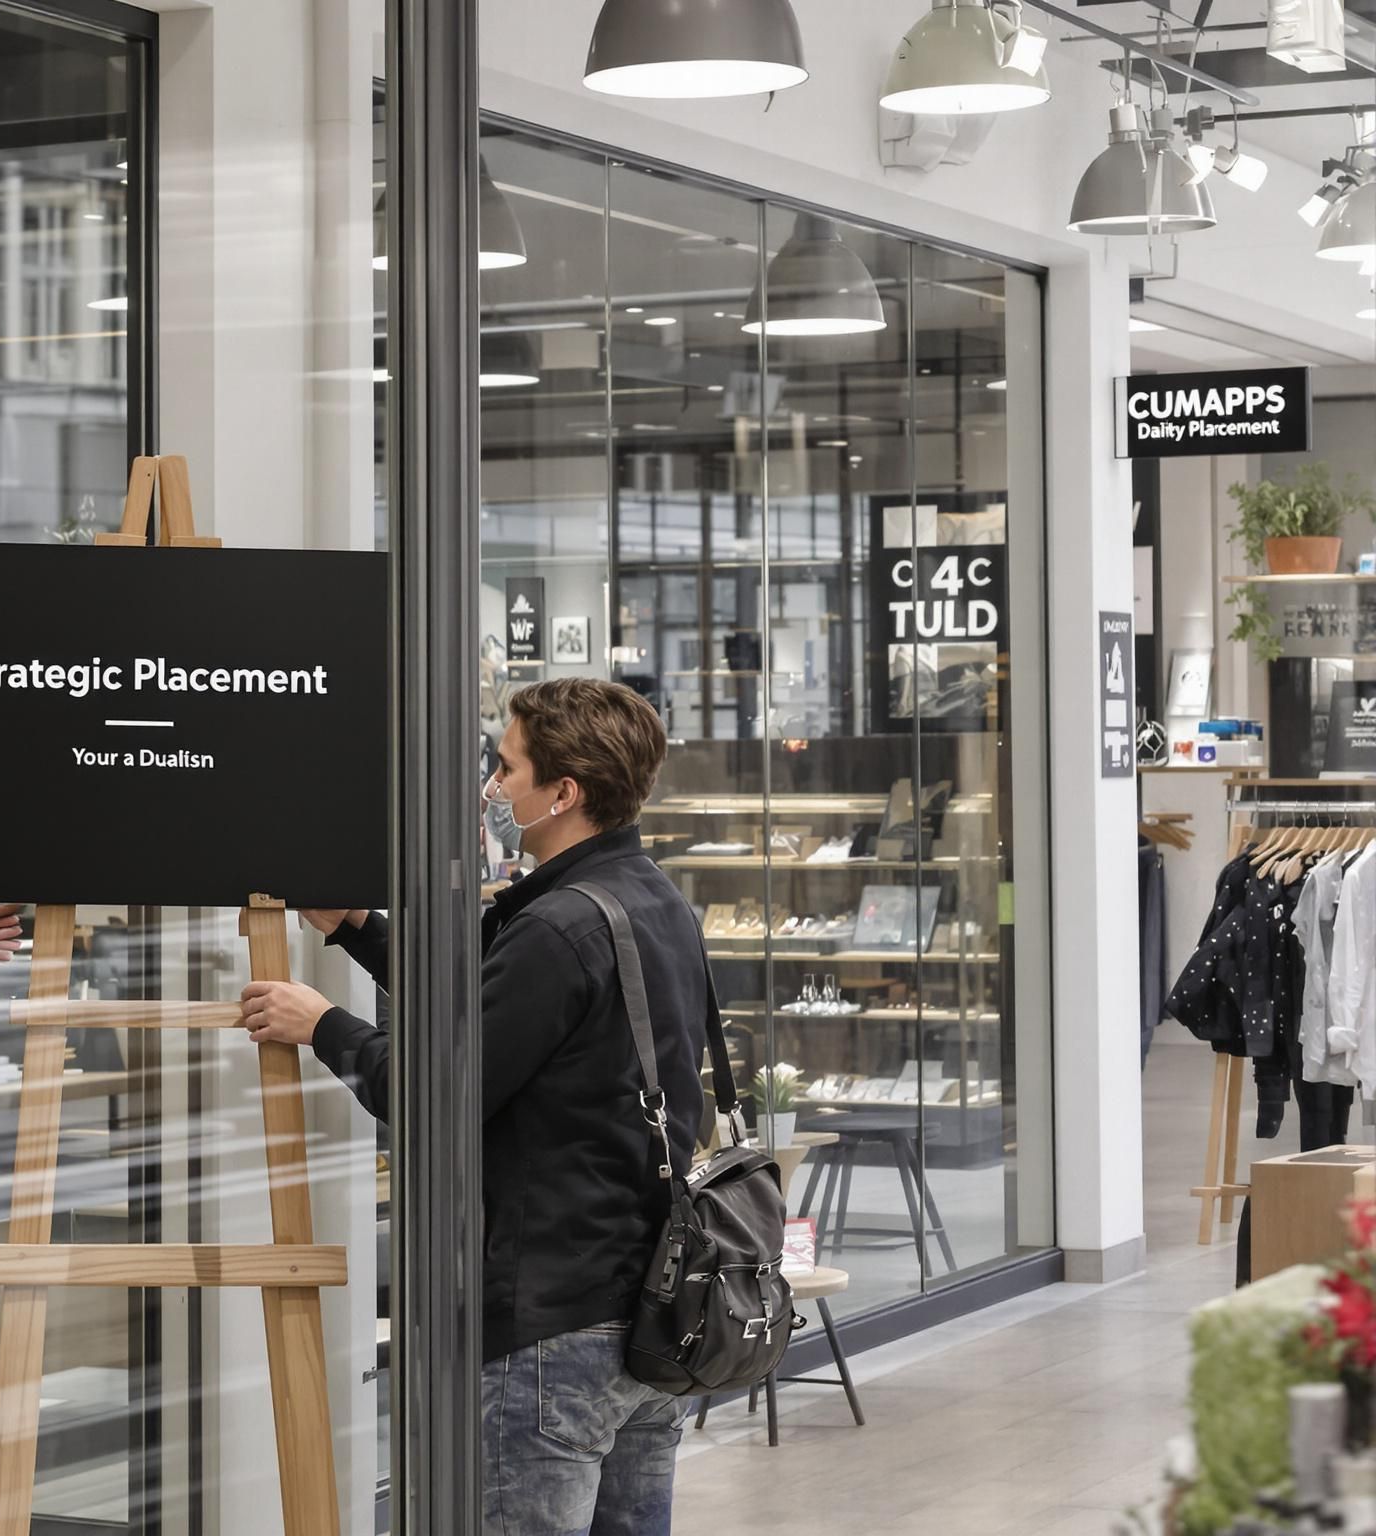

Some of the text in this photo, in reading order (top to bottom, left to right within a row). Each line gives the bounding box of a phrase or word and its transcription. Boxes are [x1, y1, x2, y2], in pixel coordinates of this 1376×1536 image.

[1128, 384, 1286, 420] CUMAPPS
[888, 599, 998, 638] TULD
[134, 657, 327, 694] Placement
[72, 747, 118, 766] Your
[123, 752, 134, 766] a
